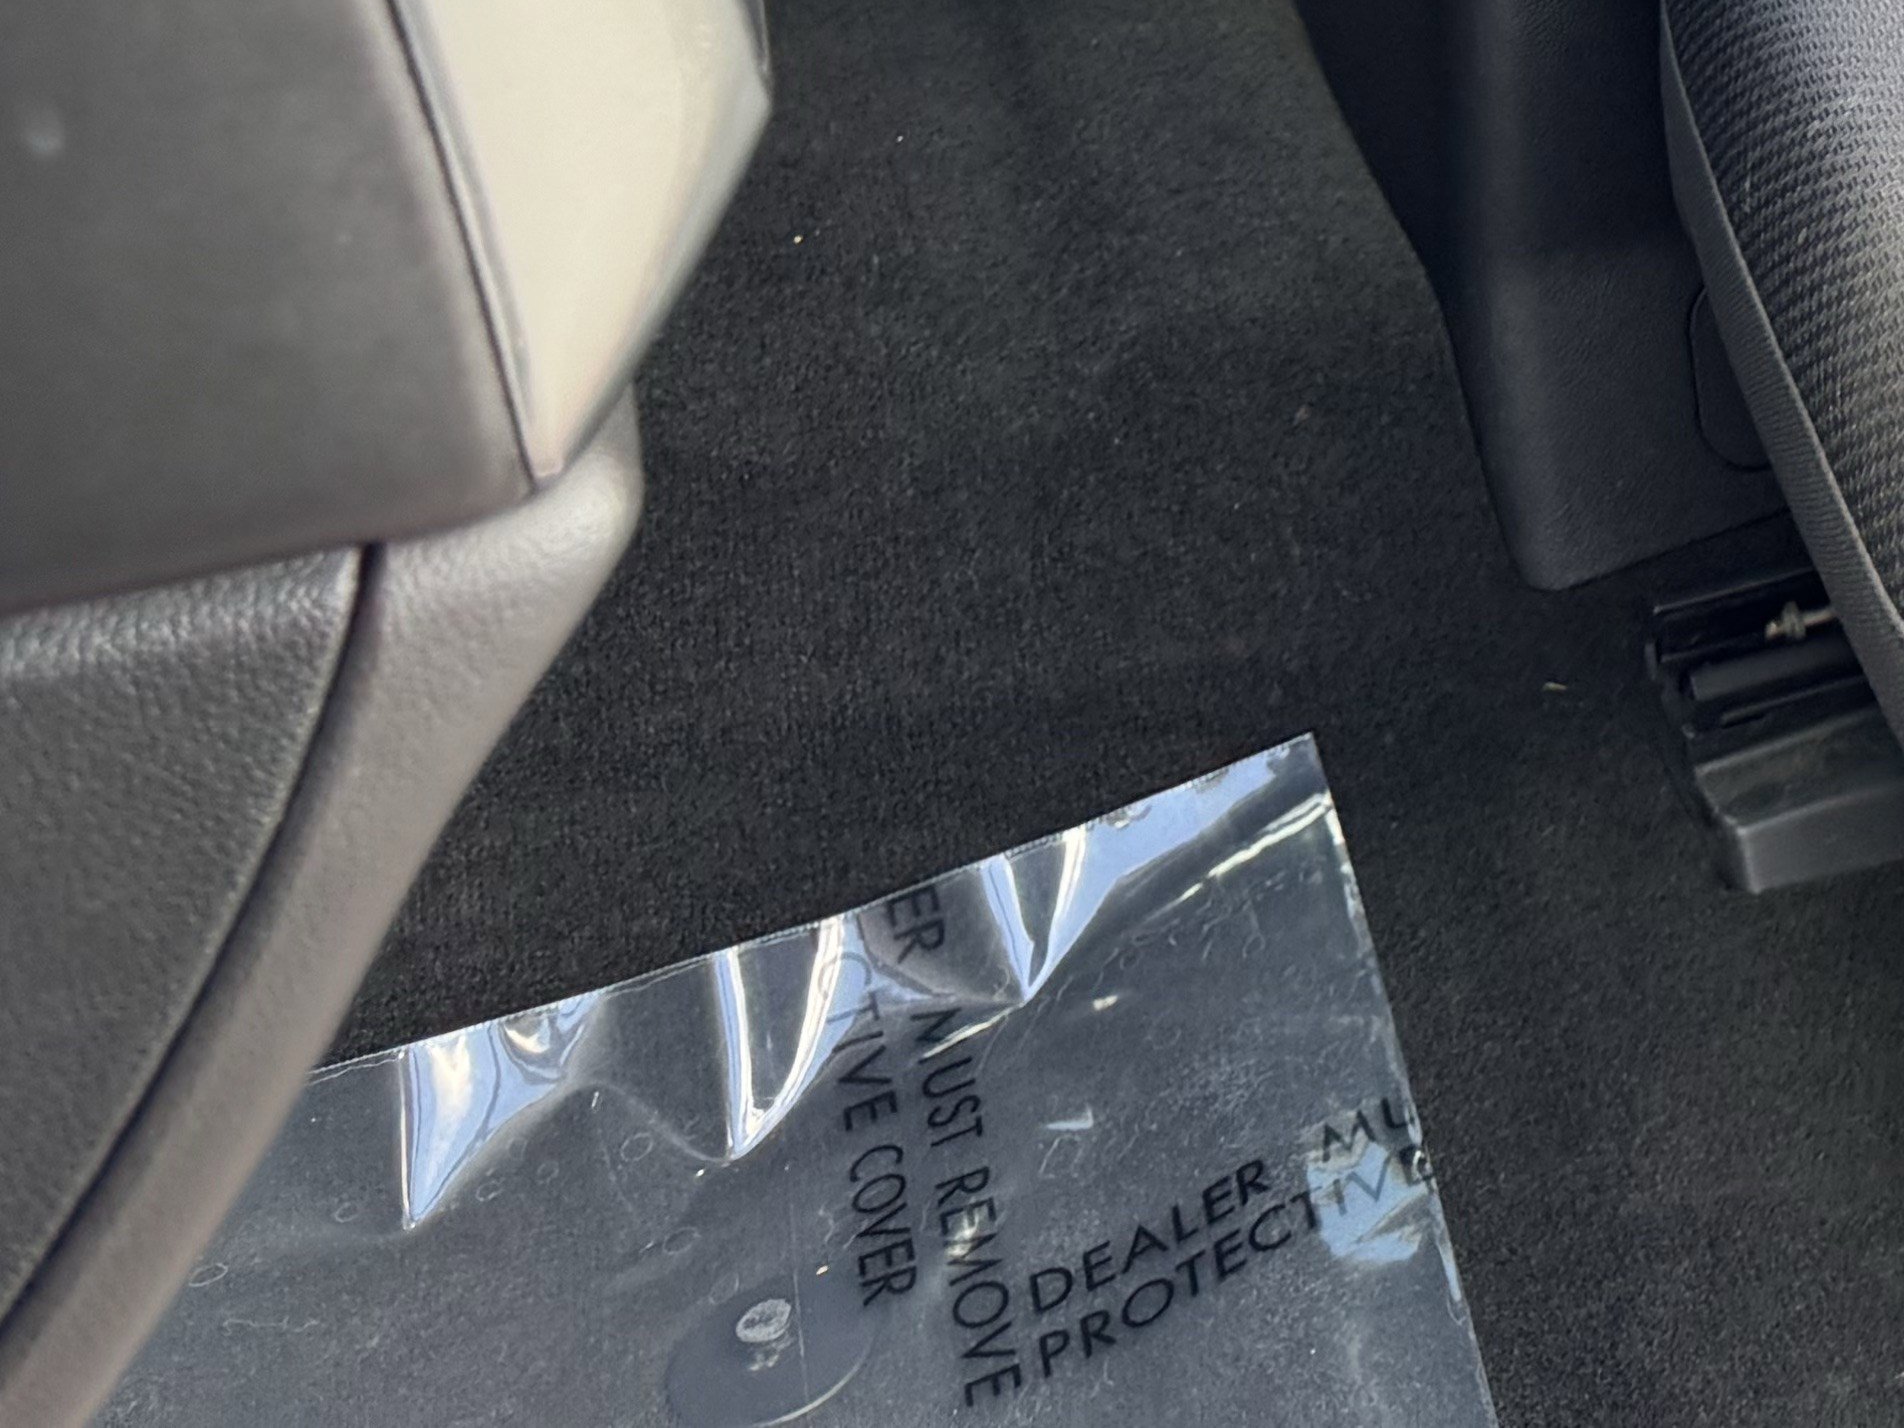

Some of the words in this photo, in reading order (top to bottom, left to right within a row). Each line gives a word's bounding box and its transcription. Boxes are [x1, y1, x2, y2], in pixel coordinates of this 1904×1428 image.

[850, 1144, 918, 1307] COVER
[934, 1166, 1023, 1408] REMOVE
[1029, 1158, 1272, 1315] DEALER
